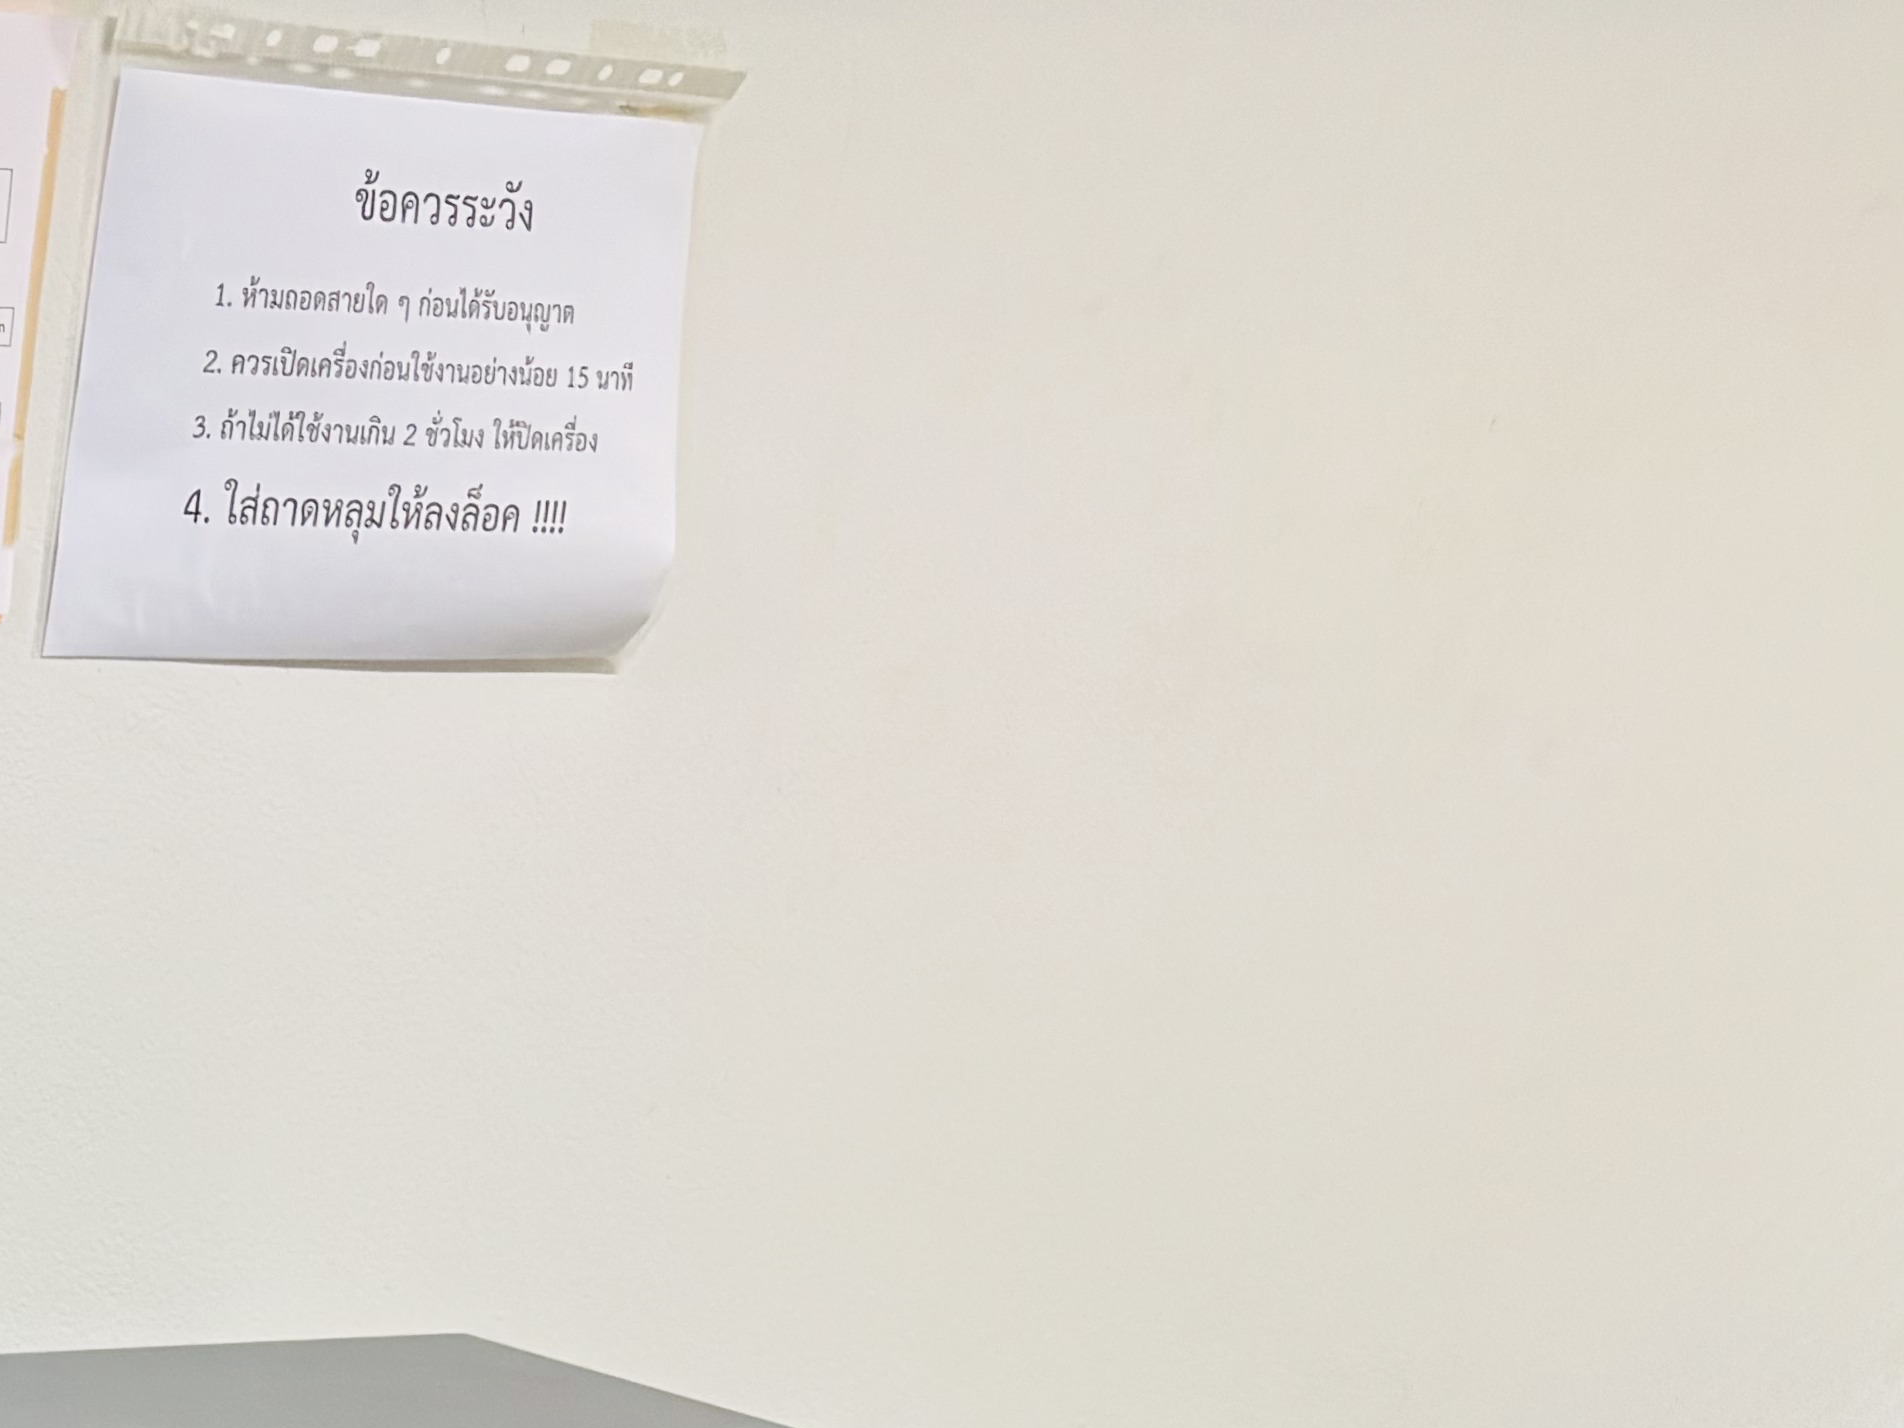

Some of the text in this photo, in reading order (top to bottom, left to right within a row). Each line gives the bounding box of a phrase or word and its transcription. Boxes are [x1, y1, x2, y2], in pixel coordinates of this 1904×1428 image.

[355, 168, 533, 231] ข้อควรระวัง
[215, 282, 232, 308] 1.
[242, 275, 389, 315] ห้ามถอดสายใด
[419, 287, 575, 335] ก่อนได้รับอนุญาต
[203, 341, 634, 392] 2. ควรเปิดเครื่องก่อนใช้งานอย่างน้อย 15 นาที
[192, 408, 598, 453] 3. ถ้าไม่ได้ใช้งานเกิน 2 ชั่วโมง ให้ปิดเครื่อง
[183, 478, 567, 544] 4. ใส่ถาดหลุมให้ลงล็อค !!!!
